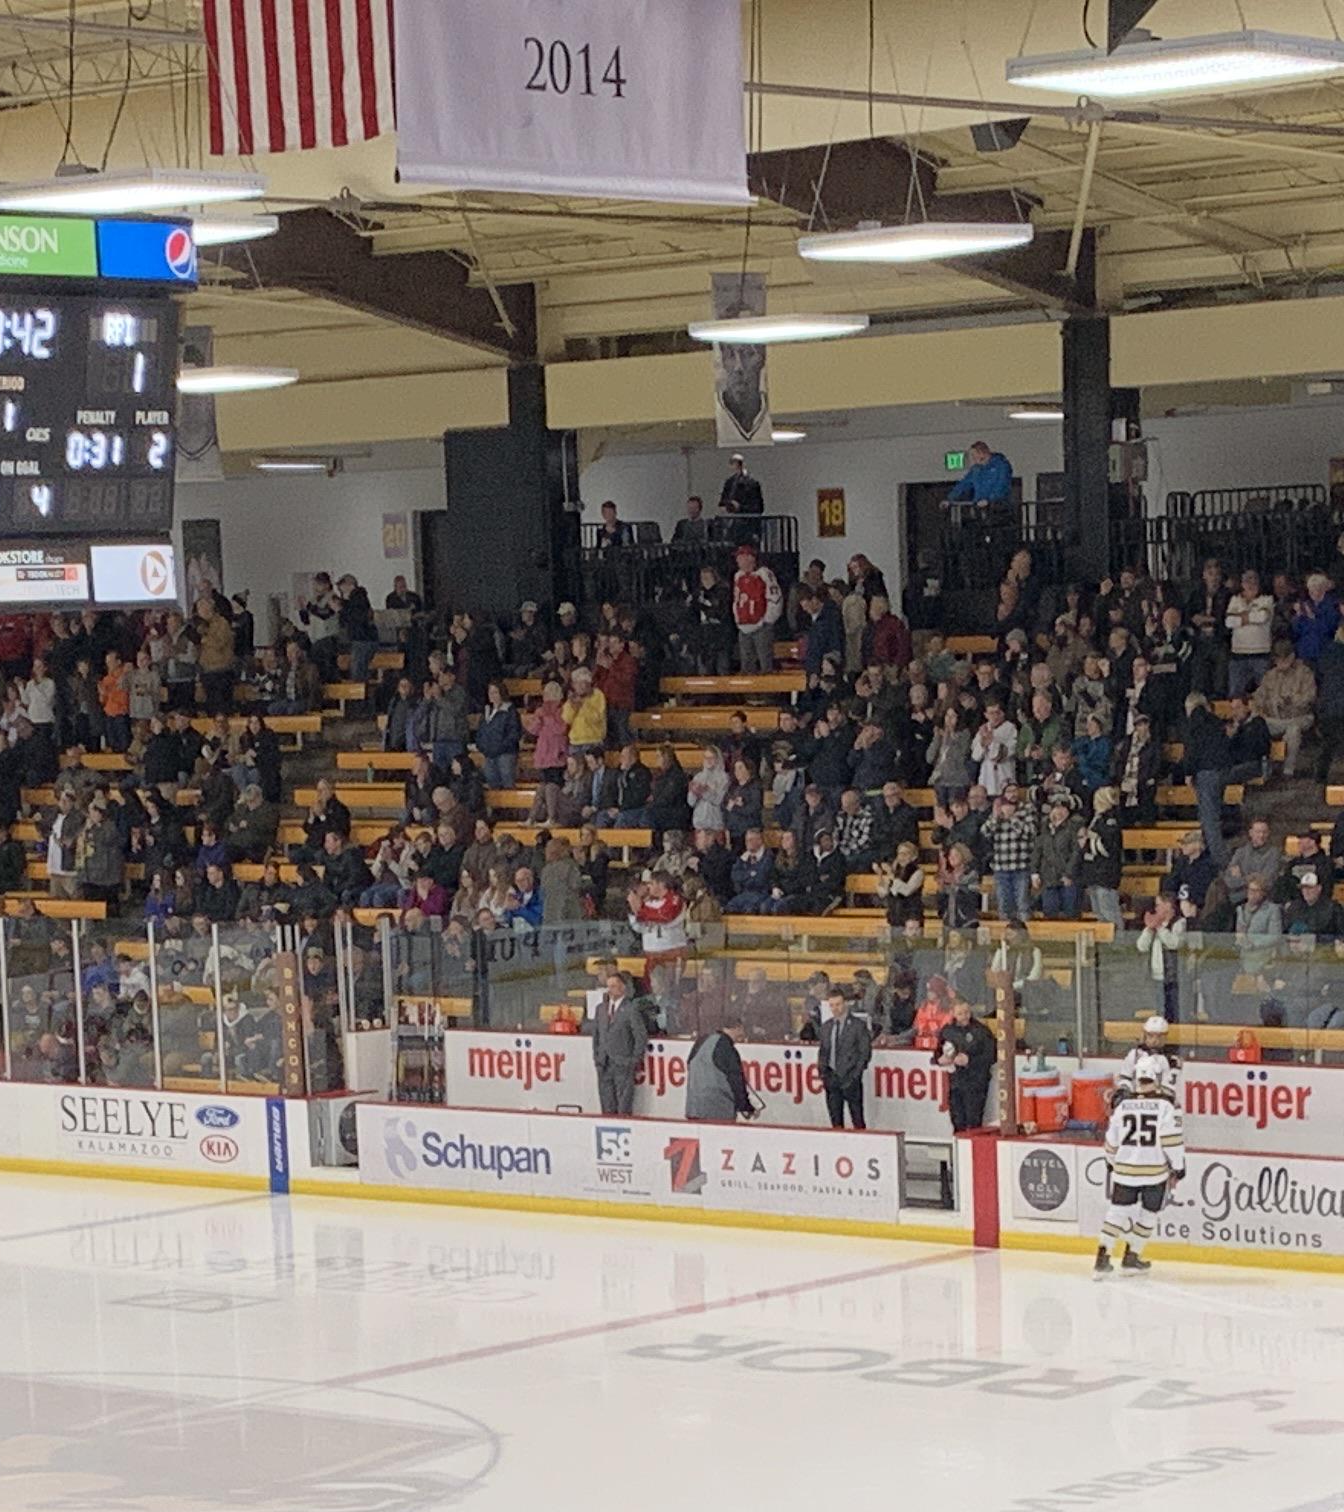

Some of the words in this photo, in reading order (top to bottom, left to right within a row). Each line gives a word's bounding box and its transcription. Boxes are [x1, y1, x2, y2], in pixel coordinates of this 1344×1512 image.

[524, 37, 627, 98] 2014
[77, 410, 116, 425] PENALTY
[135, 410, 169, 425] PLAYER
[66, 430, 123, 469] 0:31
[148, 432, 167, 469] 2
[821, 500, 843, 525] 18
[283, 967, 299, 1084] BRONCOS
[468, 1038, 565, 1090] meijer
[633, 1043, 686, 1096] eije
[741, 1049, 824, 1105] meije
[874, 1060, 952, 1112] meij
[60, 1095, 189, 1140] SEELYE
[204, 1107, 232, 1128] Ford
[1185, 1071, 1311, 1129] meijer
[77, 1140, 174, 1157] KALAMAZOO
[206, 1140, 233, 1158] KIA
[1122, 1114, 1158, 1146] 25
[421, 1131, 552, 1180] Schupan
[597, 1168, 633, 1185] WEST
[721, 1149, 881, 1181] ZAZIOS
[1202, 1222, 1323, 1248] Solutions
